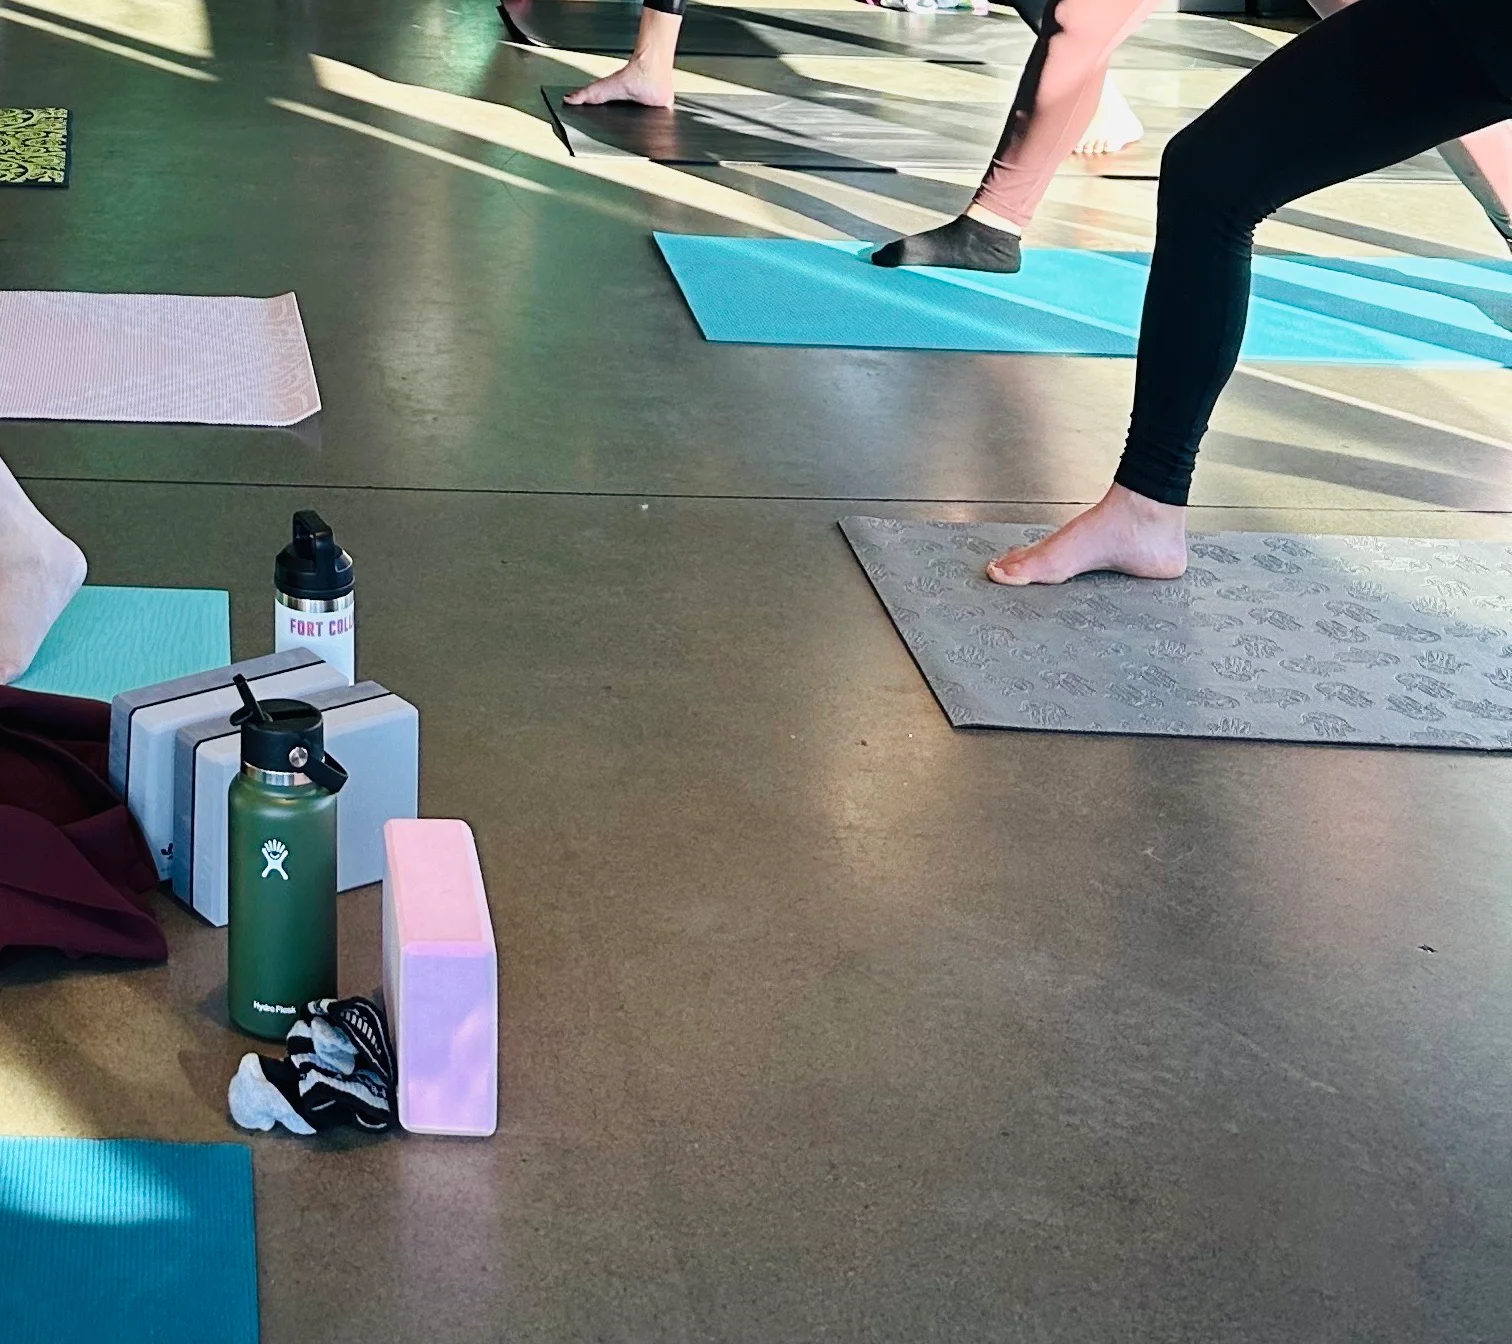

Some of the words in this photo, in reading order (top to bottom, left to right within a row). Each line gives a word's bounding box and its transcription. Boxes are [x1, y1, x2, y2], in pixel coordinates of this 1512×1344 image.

[290, 618, 324, 637] FORT
[329, 614, 354, 637] COLL
[253, 1000, 275, 1013] Hydro
[275, 1005, 297, 1014] Flask
